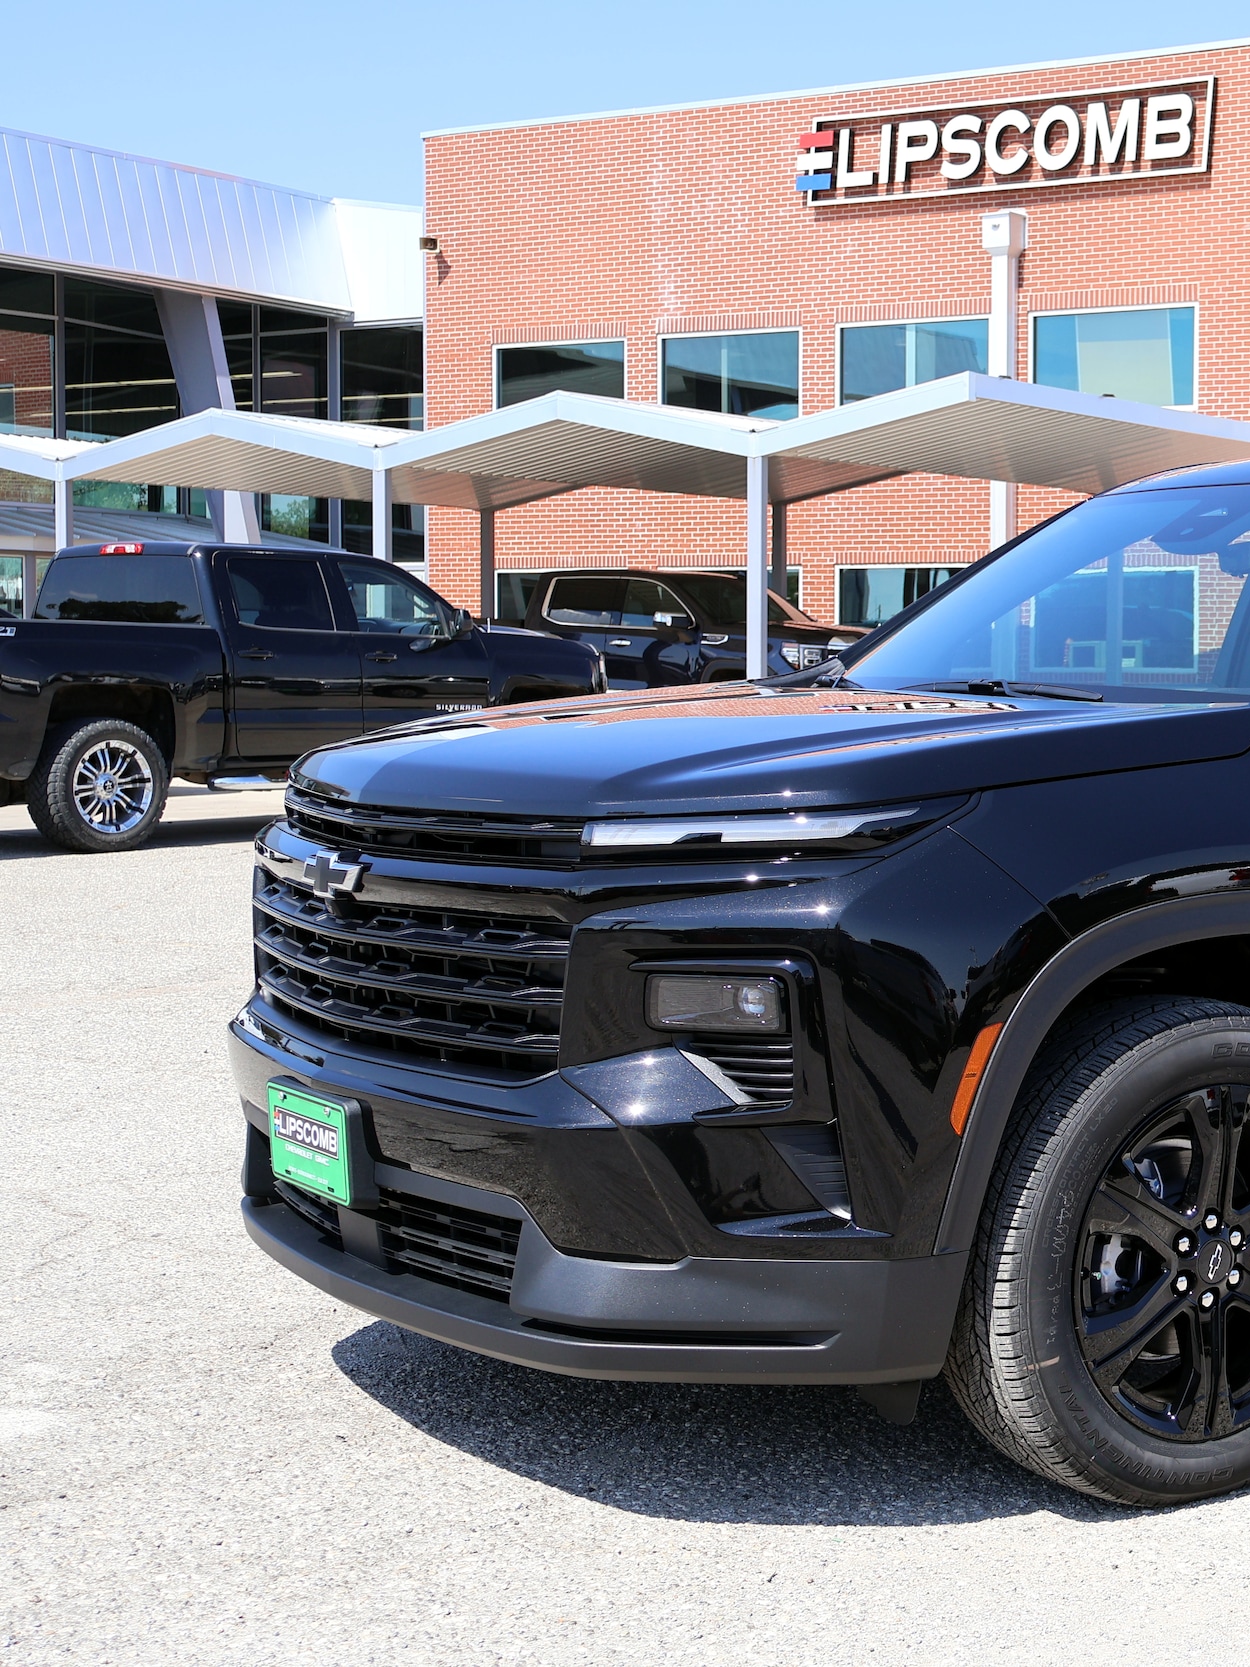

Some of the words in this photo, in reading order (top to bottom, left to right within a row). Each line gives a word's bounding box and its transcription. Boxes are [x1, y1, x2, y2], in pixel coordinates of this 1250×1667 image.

[836, 92, 1195, 189] LIPSCOMB
[279, 1112, 338, 1154] LIPSCOMB
[1057, 1384, 1234, 1486] CONTINENTAL
